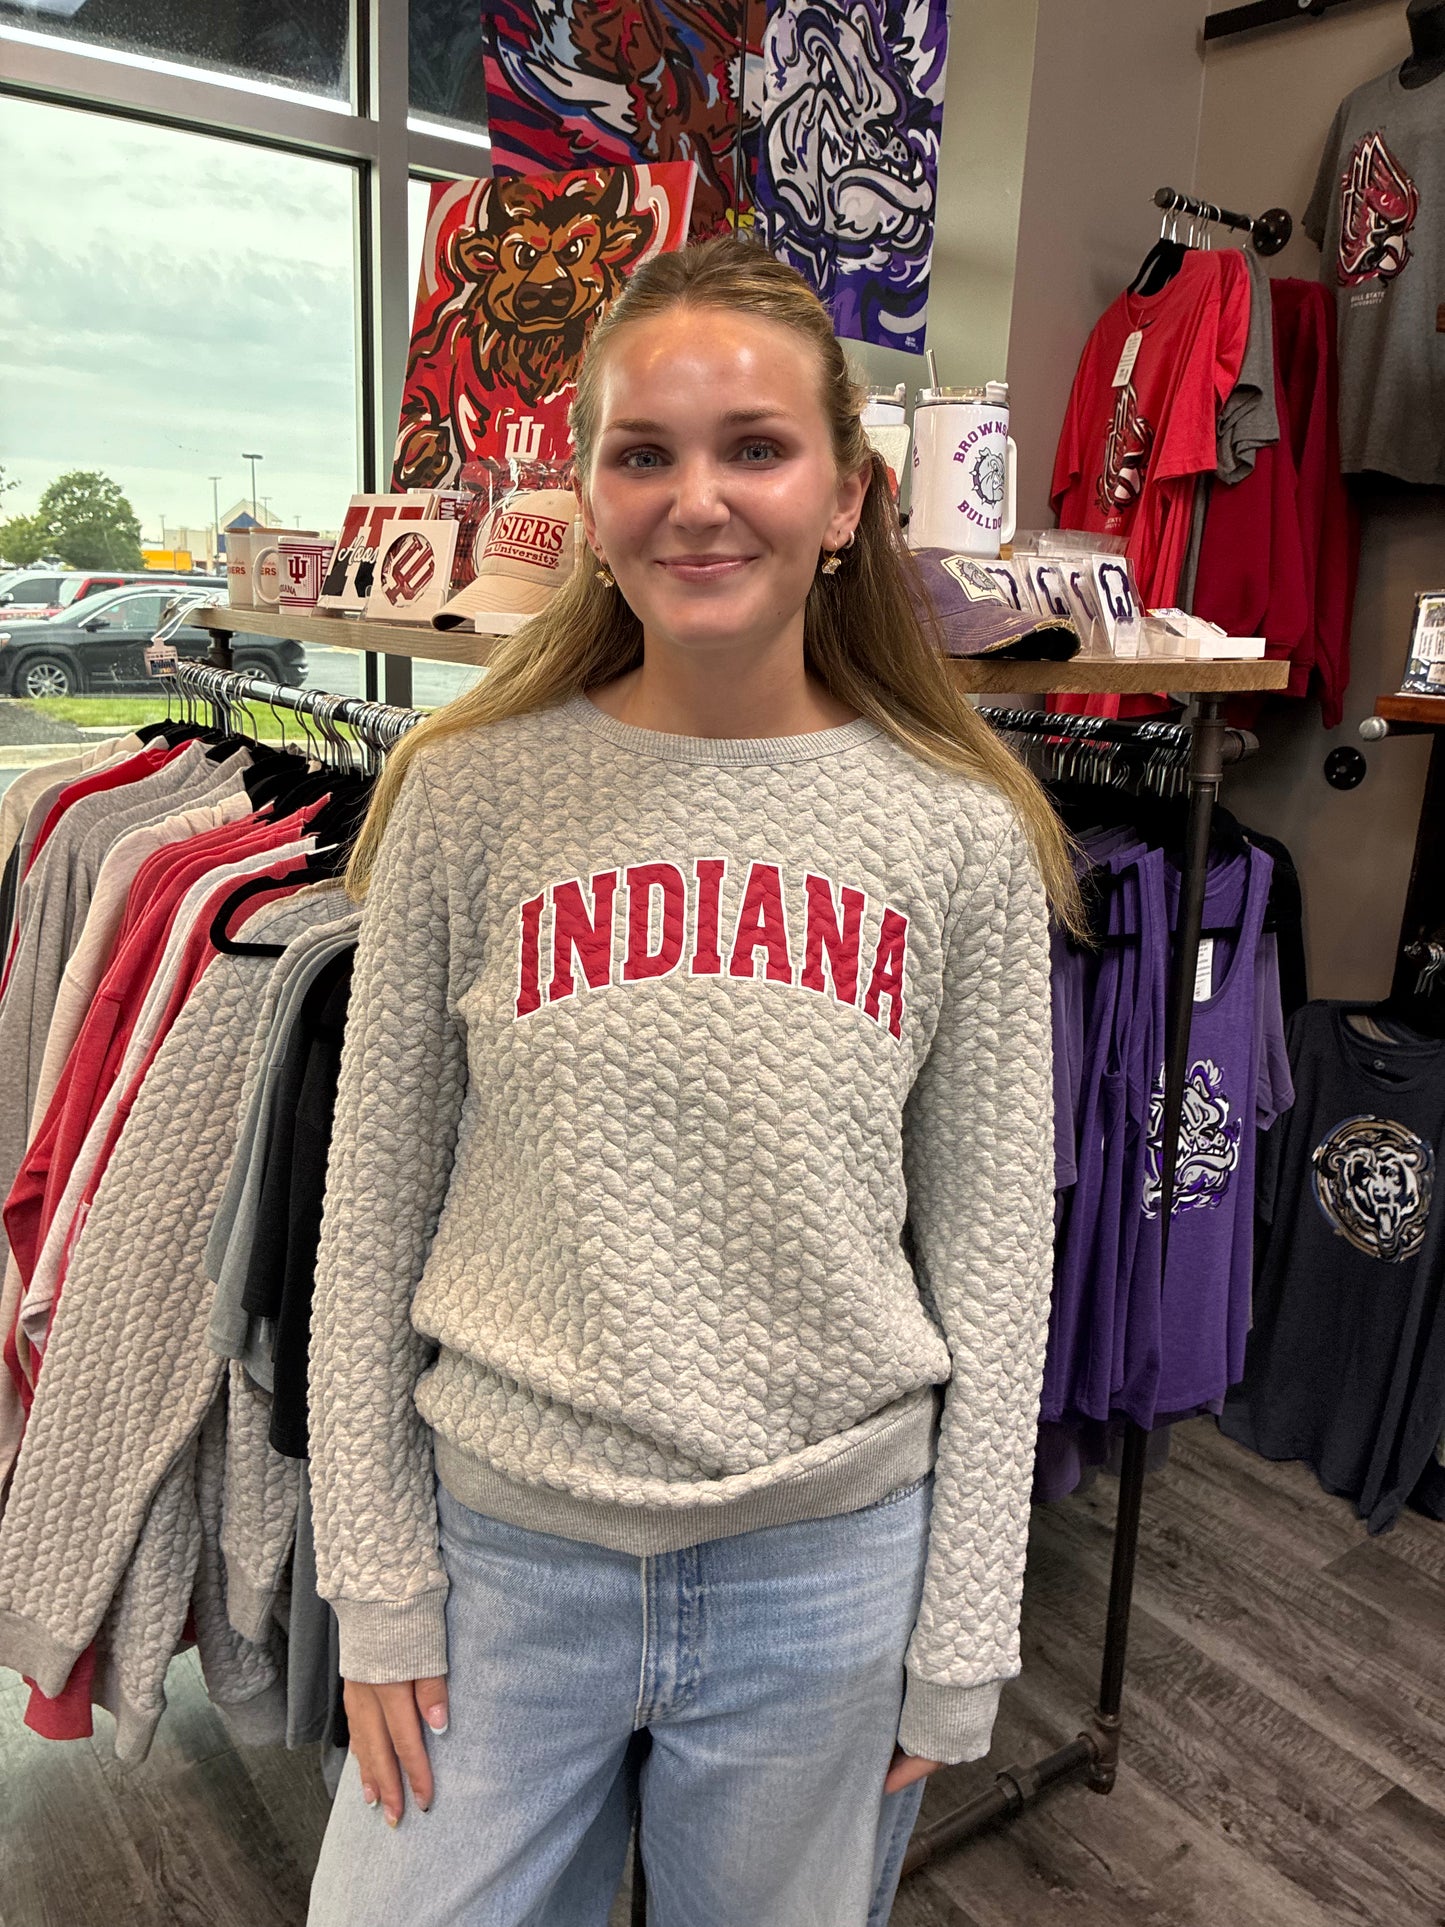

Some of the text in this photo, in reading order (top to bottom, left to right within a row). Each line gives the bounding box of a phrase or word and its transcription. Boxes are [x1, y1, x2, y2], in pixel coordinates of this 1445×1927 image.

[953, 421, 1008, 463] BROWNS
[489, 515, 567, 552] OSIERS
[494, 544, 559, 566] University
[513, 857, 909, 1046] INDIANA
